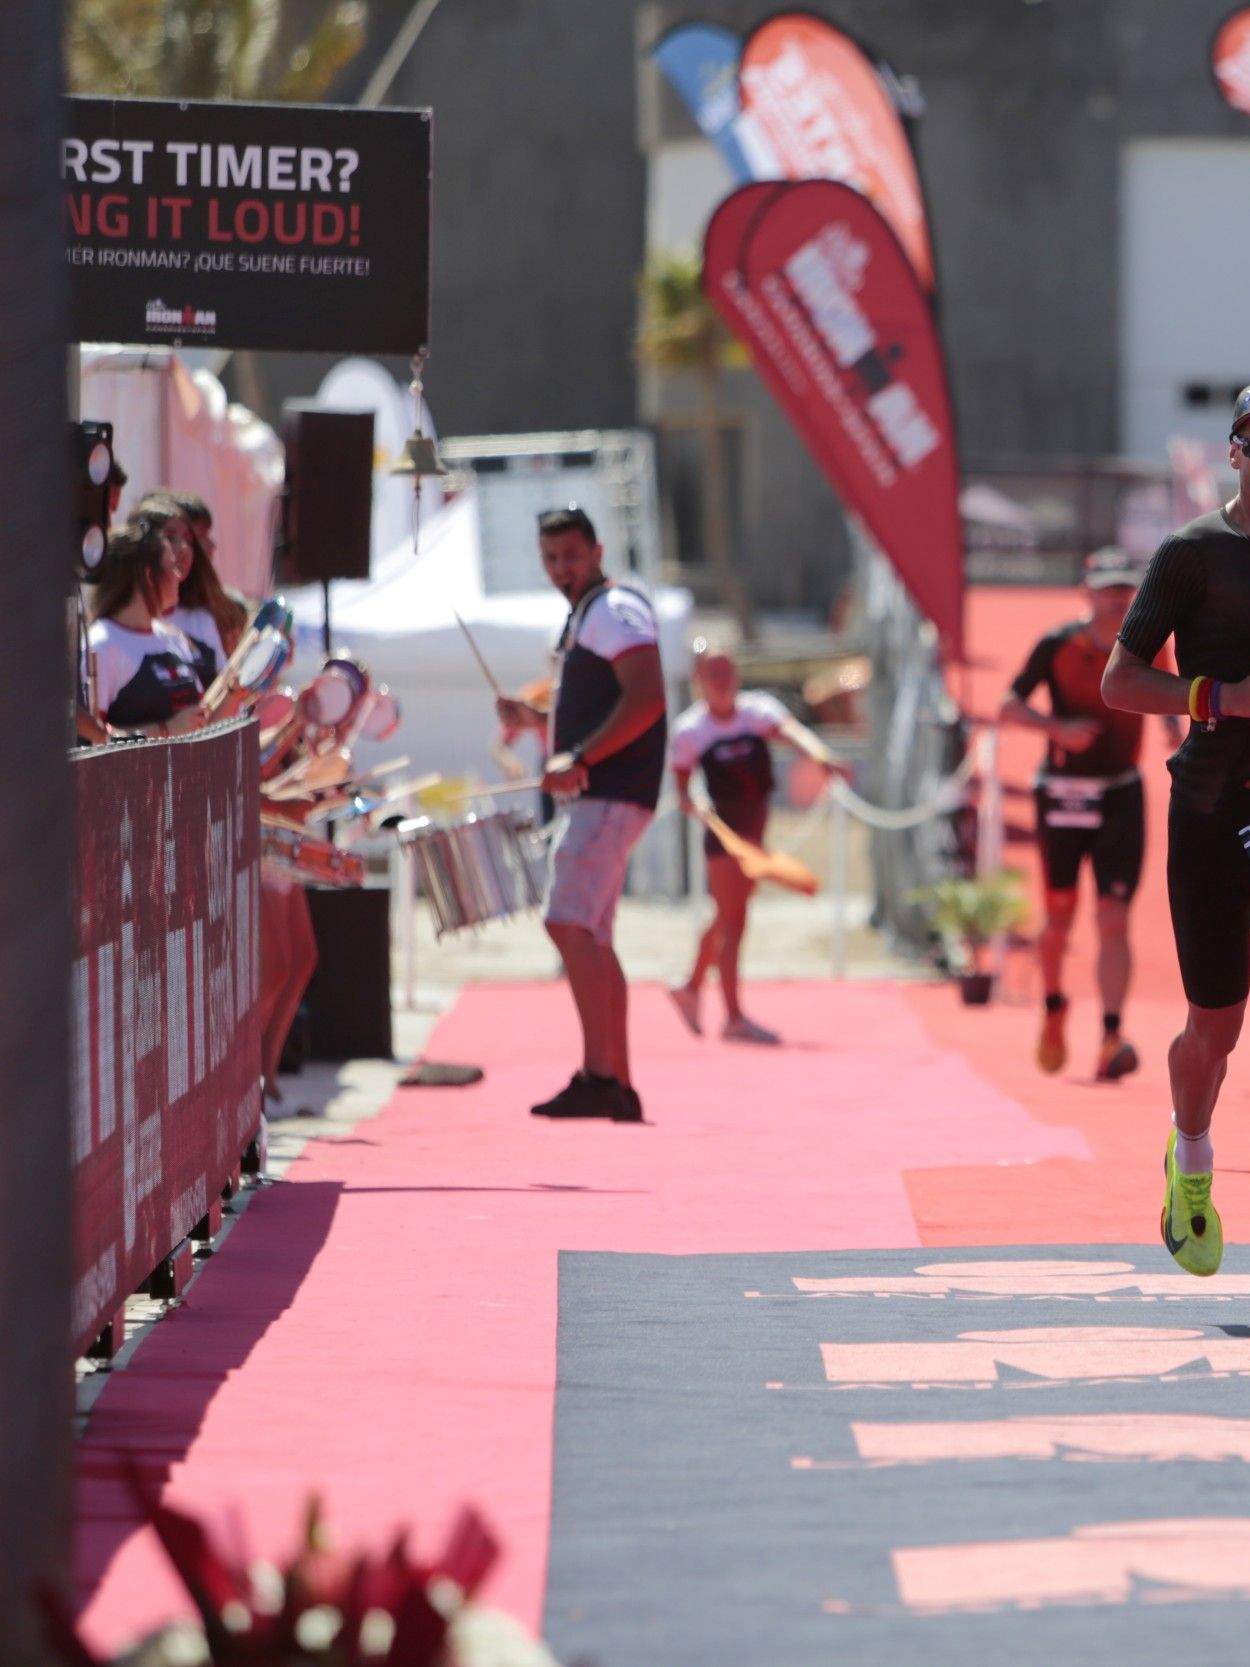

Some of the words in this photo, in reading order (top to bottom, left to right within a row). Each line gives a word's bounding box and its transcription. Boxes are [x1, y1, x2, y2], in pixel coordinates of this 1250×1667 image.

[166, 142, 360, 193] TIMER?
[147, 197, 193, 239] IT
[208, 199, 361, 246] LOUD!
[99, 248, 190, 269] IRONMAN?
[238, 254, 296, 274] SUENE
[300, 256, 371, 276] FUERTE!
